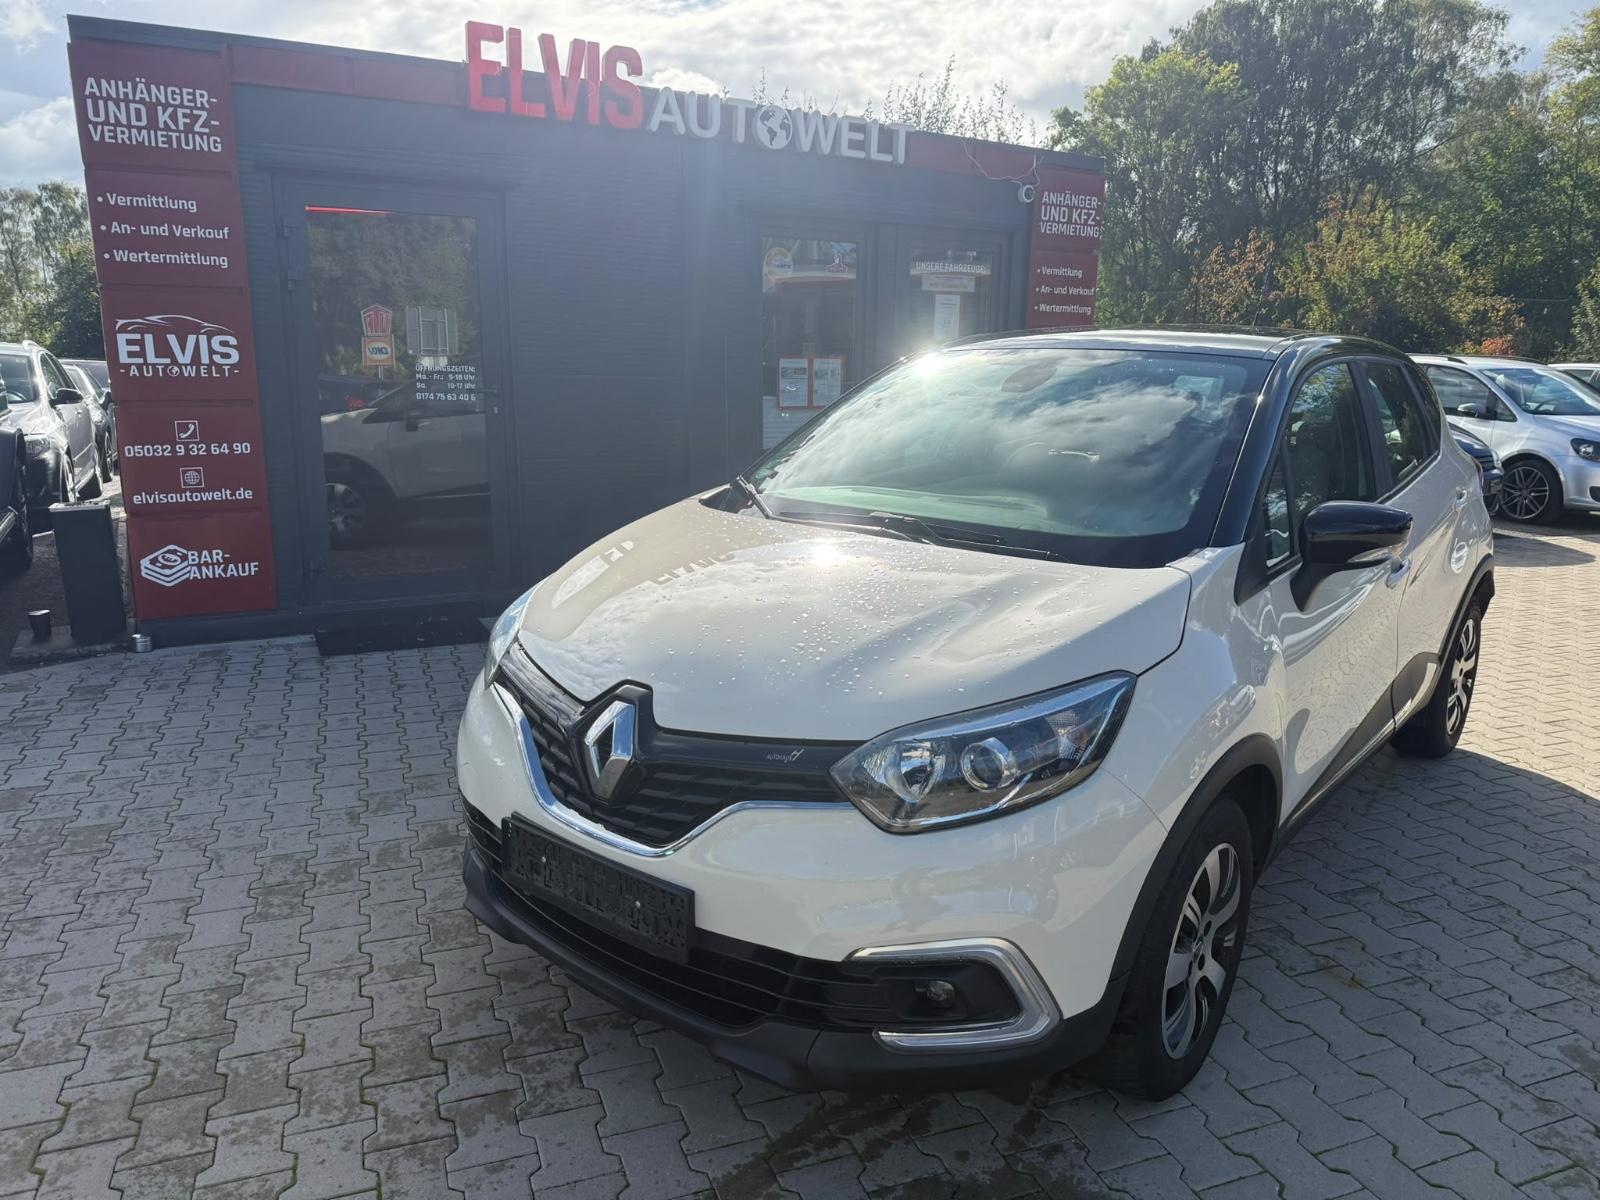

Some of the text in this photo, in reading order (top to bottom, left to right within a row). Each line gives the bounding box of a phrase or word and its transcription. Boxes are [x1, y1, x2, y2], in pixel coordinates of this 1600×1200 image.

[465, 20, 644, 129] ELVIS
[84, 77, 218, 108] ANHÄNGER-
[86, 98, 220, 133] UND KFZ-
[88, 124, 222, 153] VERMIETUNG
[106, 193, 197, 213] Vermittlung
[1042, 190, 1101, 209] ANHÄNGER-
[1041, 205, 1100, 225] UND KFZ-
[111, 221, 230, 239] An- und Verkauf
[1040, 222, 1099, 238] VERMIETUNG
[113, 250, 228, 268] Wertermittlung
[915, 261, 943, 272] UNSERE
[1042, 266, 1083, 278] Vermittlung
[1040, 285, 1095, 296] An- und Verkauf
[1039, 304, 1092, 315] Wertermittlung
[116, 333, 240, 365] ELVIS
[416, 392, 434, 400] 0174
[459, 393, 469, 401] 40
[124, 442, 251, 457] 05032 9 32 64 90
[132, 488, 253, 505] elvisautowelt.de
[188, 549, 230, 565] BAR-
[189, 562, 259, 580] ANKAUF
